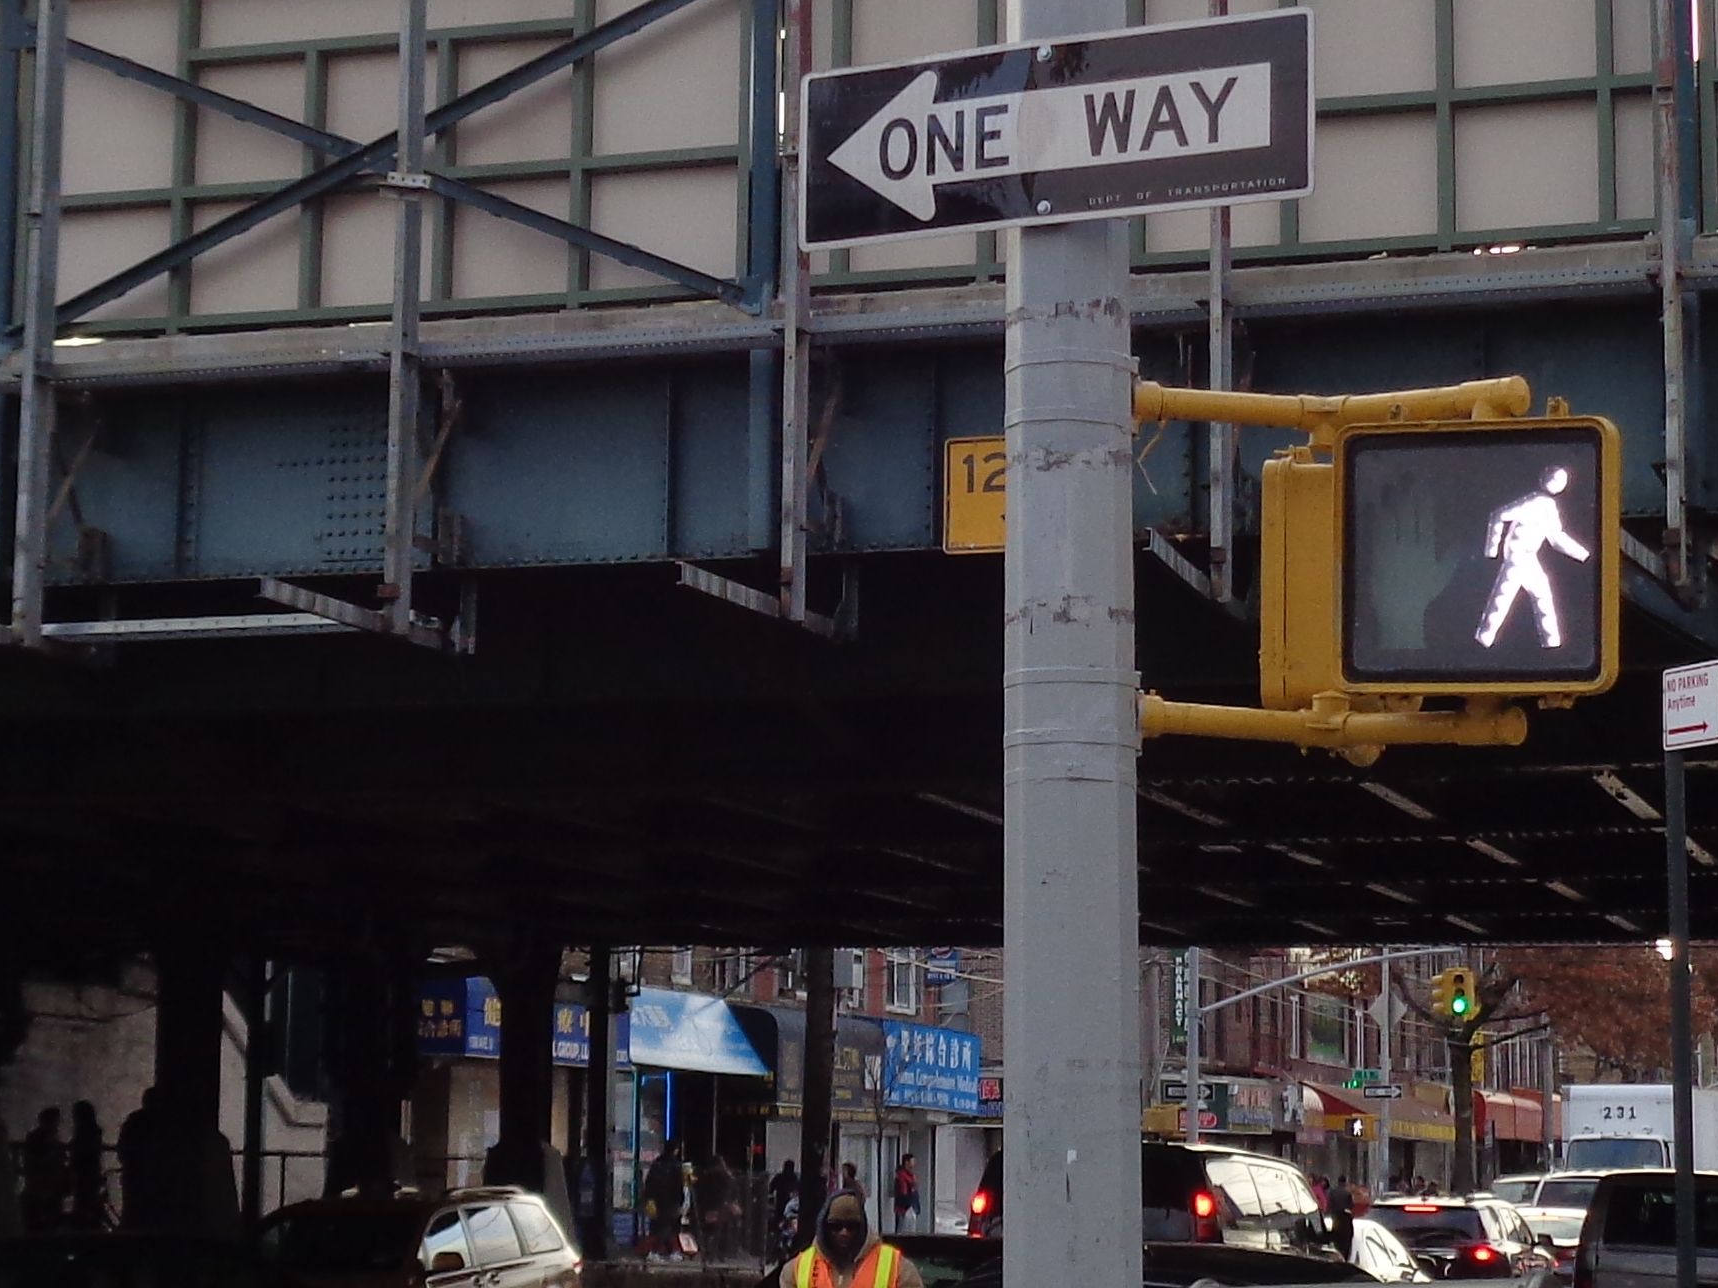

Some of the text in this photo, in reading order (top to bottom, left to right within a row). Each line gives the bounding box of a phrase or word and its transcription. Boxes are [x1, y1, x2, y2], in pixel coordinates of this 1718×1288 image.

[879, 76, 1238, 181] ONE WAY
[1088, 177, 1286, 206] DEPT OF TRANSPORTATION
[1667, 673, 1709, 692] NO PARKING
[1668, 695, 1696, 712] Anytime
[1175, 956, 1183, 1027] PHARMACY
[1602, 1106, 1638, 1120] 231
